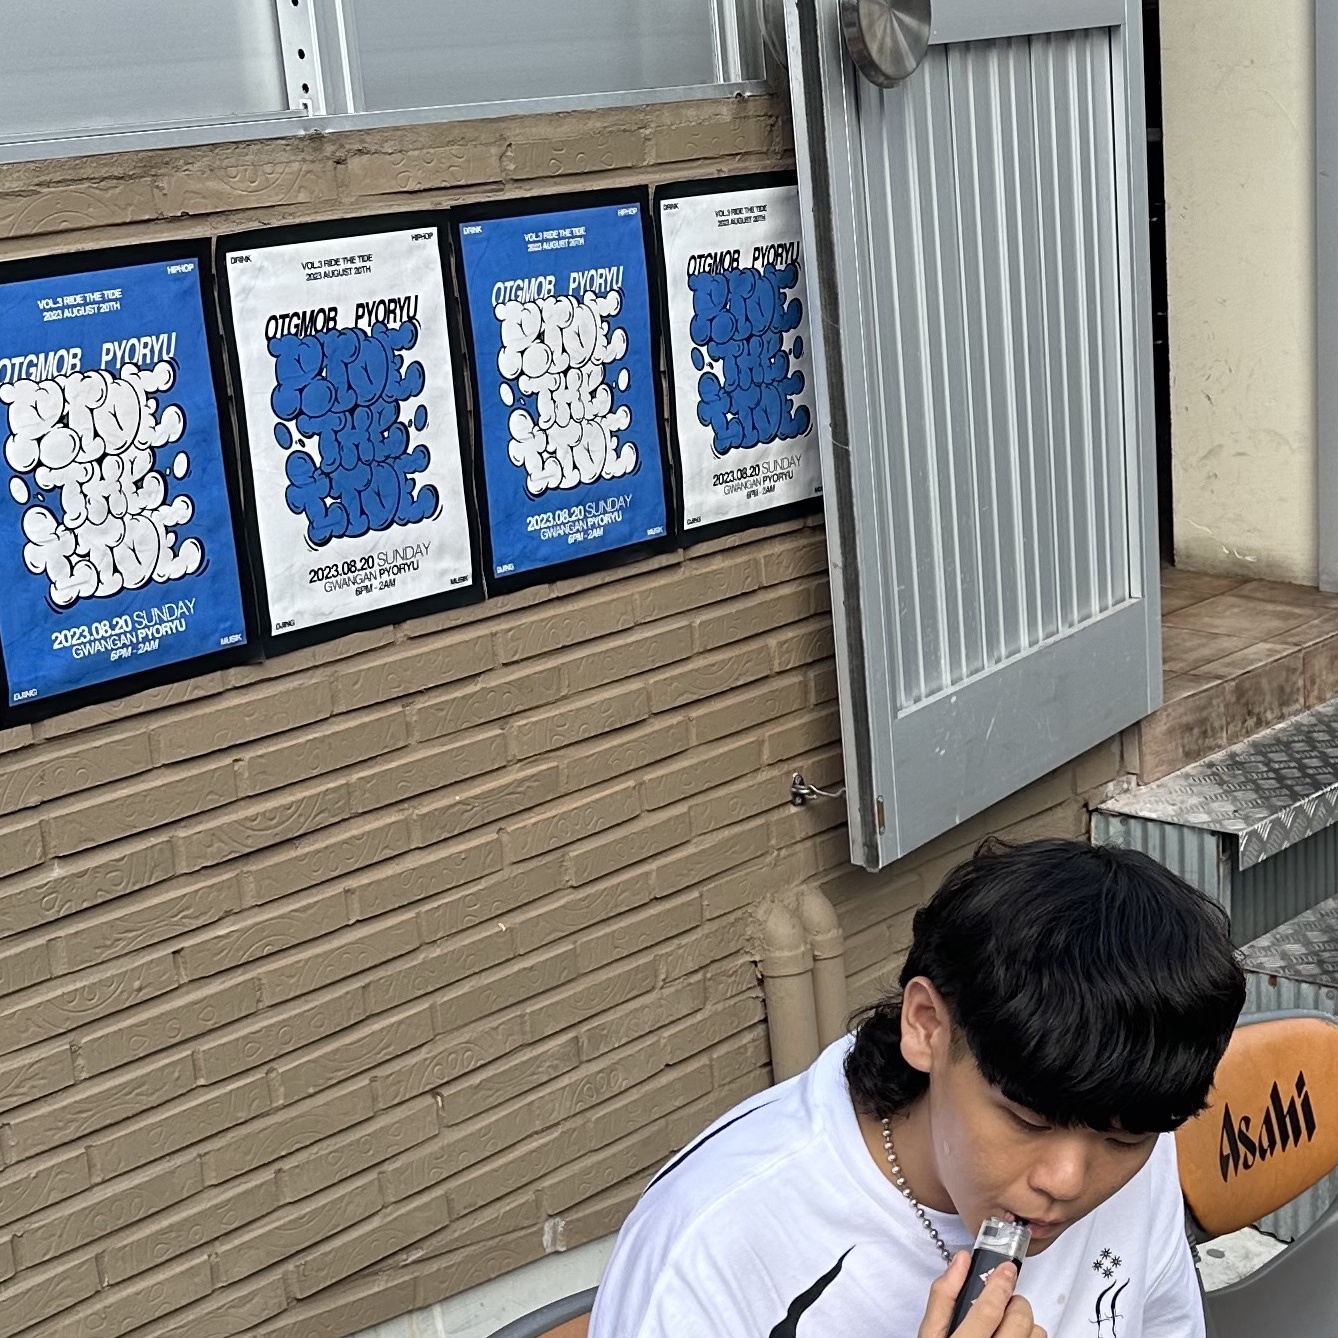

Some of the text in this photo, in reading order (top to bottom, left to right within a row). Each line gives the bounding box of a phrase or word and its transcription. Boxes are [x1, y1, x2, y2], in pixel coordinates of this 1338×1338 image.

[411, 232, 434, 242] HIPHOP
[230, 254, 252, 264] DRINK
[301, 254, 373, 271] VOL.3 RIDE THE TIDE
[752, 241, 800, 267] PYORYU
[167, 263, 194, 275] HIPHOP
[306, 265, 371, 281] 2023 AUGUST 20TH
[569, 265, 624, 294] PYORYU
[37, 289, 122, 310] VOL.3 RIDE THE TIDE
[43, 301, 120, 321] 2023 AUGUST 20TH
[355, 295, 419, 328] PYORYU
[101, 332, 176, 369] PYORYU
[526, 494, 632, 531] 2023.08.20 SUNDAY
[540, 511, 622, 540] GWANGAN PYORYU
[568, 527, 603, 544] 6PM 2AM
[309, 541, 432, 584] 2023.08.20 SUNDAY
[324, 559, 420, 593] GWANGAN PYORYU
[355, 577, 396, 597] 6PM 2AM
[51, 598, 196, 650] 2023.08.20 SUNDAY
[72, 619, 186, 659] GWANGAN PYORYU
[110, 639, 159, 661] 6PM 2AM
[1219, 1070, 1317, 1183] Asahi
